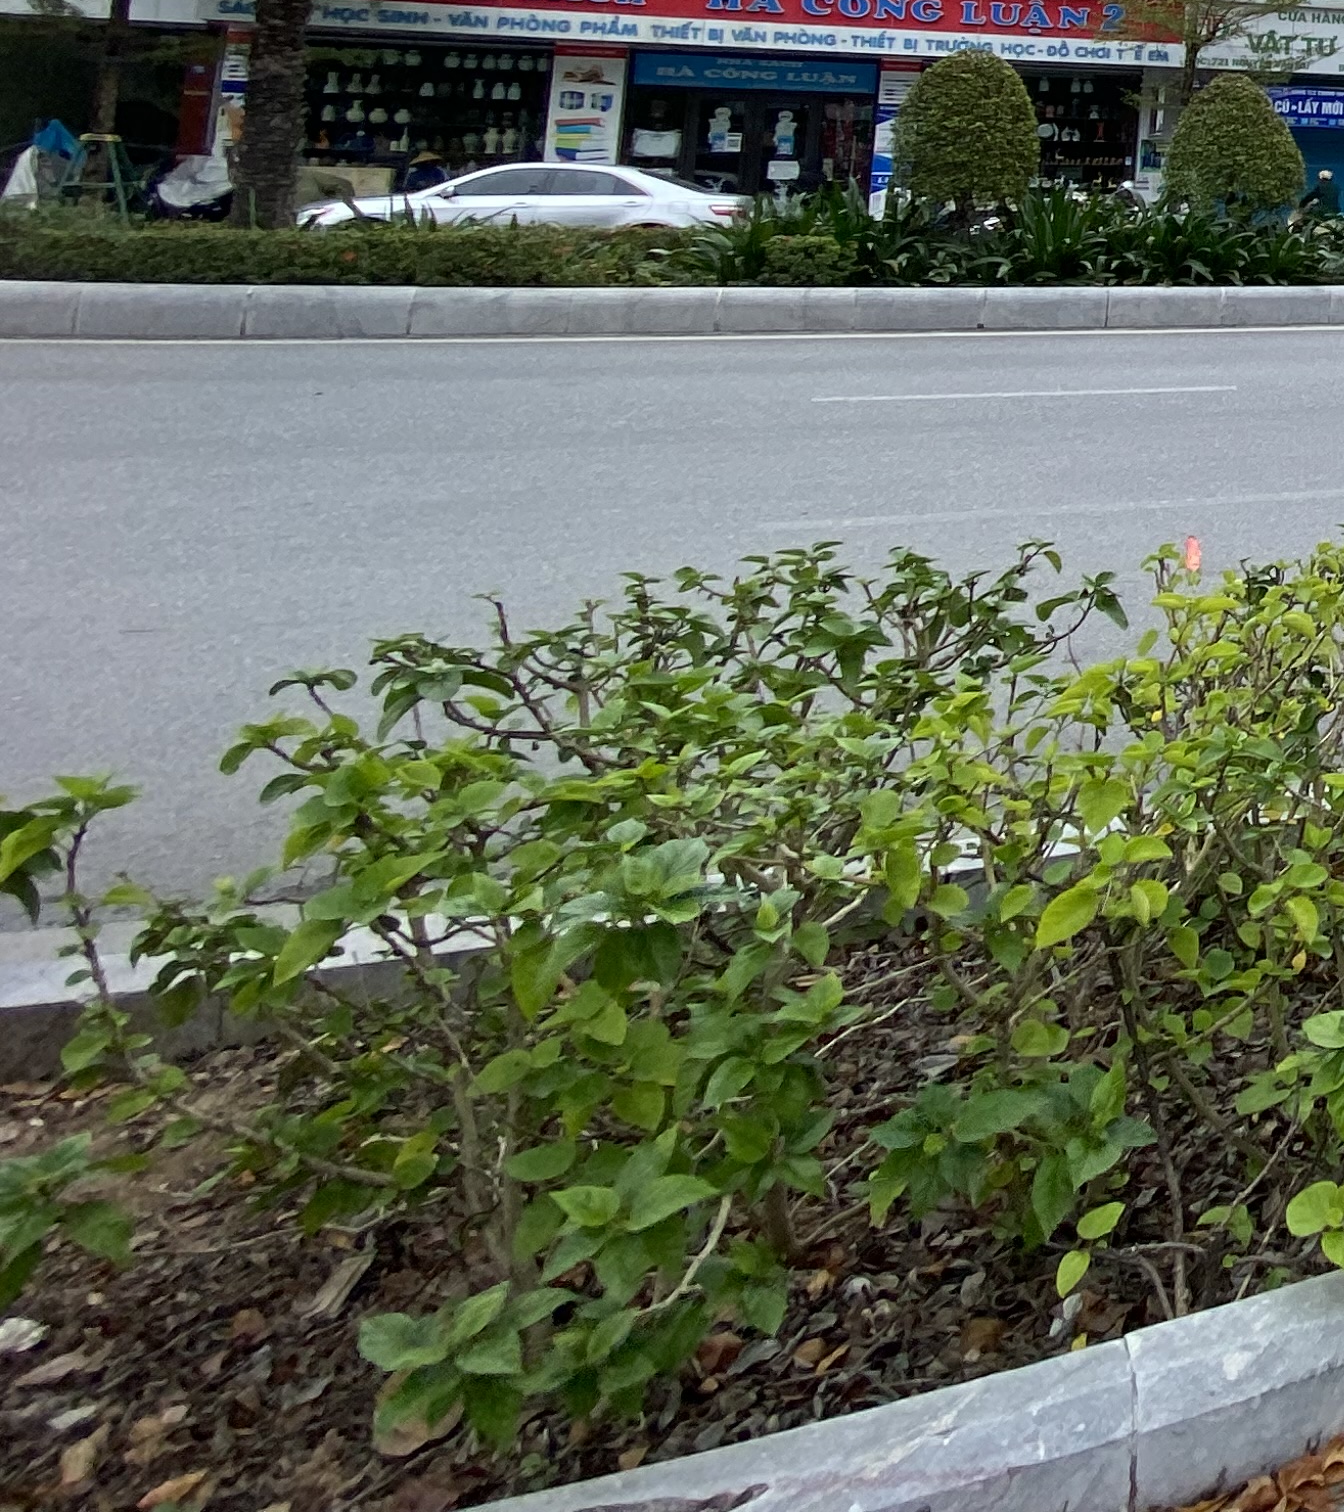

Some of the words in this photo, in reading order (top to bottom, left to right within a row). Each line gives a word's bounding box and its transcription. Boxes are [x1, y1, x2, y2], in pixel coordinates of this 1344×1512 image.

[448, 10, 489, 28] VĂN
[496, 13, 572, 34] PHÒNG
[579, 15, 639, 38] PHẨM
[652, 21, 702, 41] THIẾT
[773, 28, 837, 47] PHÒNG
[850, 30, 897, 50] THIẾT
